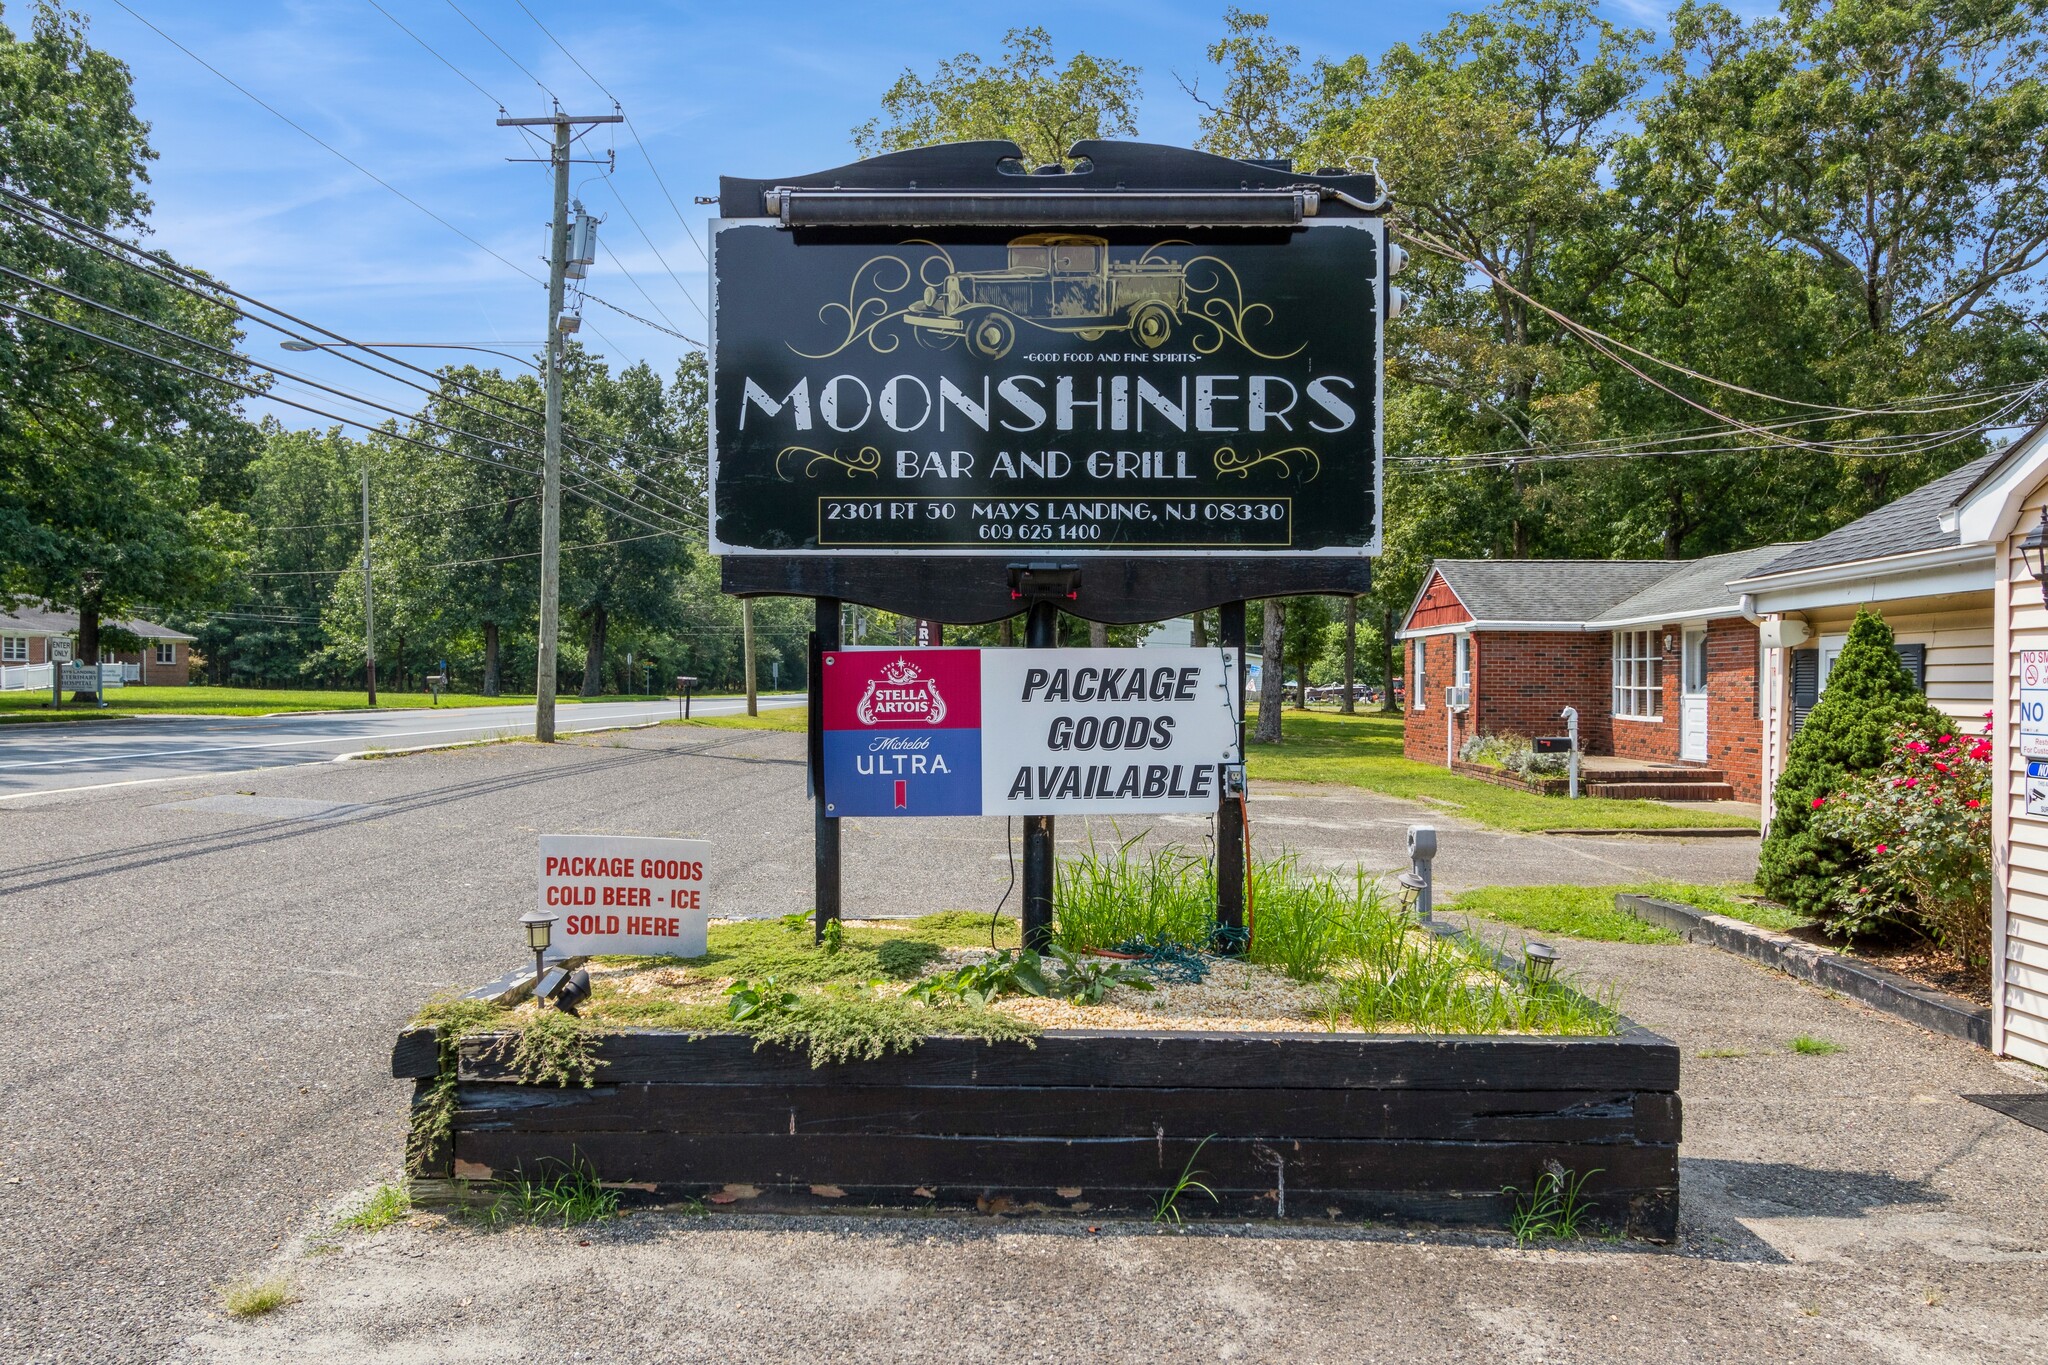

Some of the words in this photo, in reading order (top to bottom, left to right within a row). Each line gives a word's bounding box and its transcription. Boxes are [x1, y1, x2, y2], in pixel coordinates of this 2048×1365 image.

[1063, 353, 1094, 362] FOOD
[1097, 353, 1121, 362] AND
[1124, 353, 1149, 362] FINE
[739, 374, 1356, 433] MOONSHINERS
[896, 450, 975, 479] BAR
[990, 451, 1071, 479] AND
[1087, 451, 1197, 479] GRILL
[827, 502, 882, 520] 2301
[890, 502, 918, 520] RT
[925, 502, 956, 520] 50
[971, 503, 1040, 520] MAYS
[1047, 502, 1158, 522] LANDING,
[1165, 503, 1197, 521] NJ
[1204, 503, 1284, 521] 08330
[978, 524, 1013, 540] 609
[1018, 524, 1052, 540] 625
[1058, 524, 1101, 540] 1400
[2023, 652, 2036, 663] NO
[875, 689, 928, 701] STELLA
[1021, 667, 1201, 702] PACKAGE
[875, 701, 930, 713] ARTOIS
[2021, 702, 2044, 722] NO
[1047, 715, 1176, 751] GOODS
[868, 736, 932, 752] Michelob
[856, 754, 950, 775] ULTRA
[1007, 764, 1215, 800] AVAILABLE
[546, 857, 634, 877] PACKAGE
[641, 859, 703, 881] GOODS
[546, 886, 596, 906] COLD
[602, 887, 651, 907] BEER
[670, 890, 700, 909] ICE
[566, 915, 619, 935] SOLD
[626, 917, 680, 937] HERE
